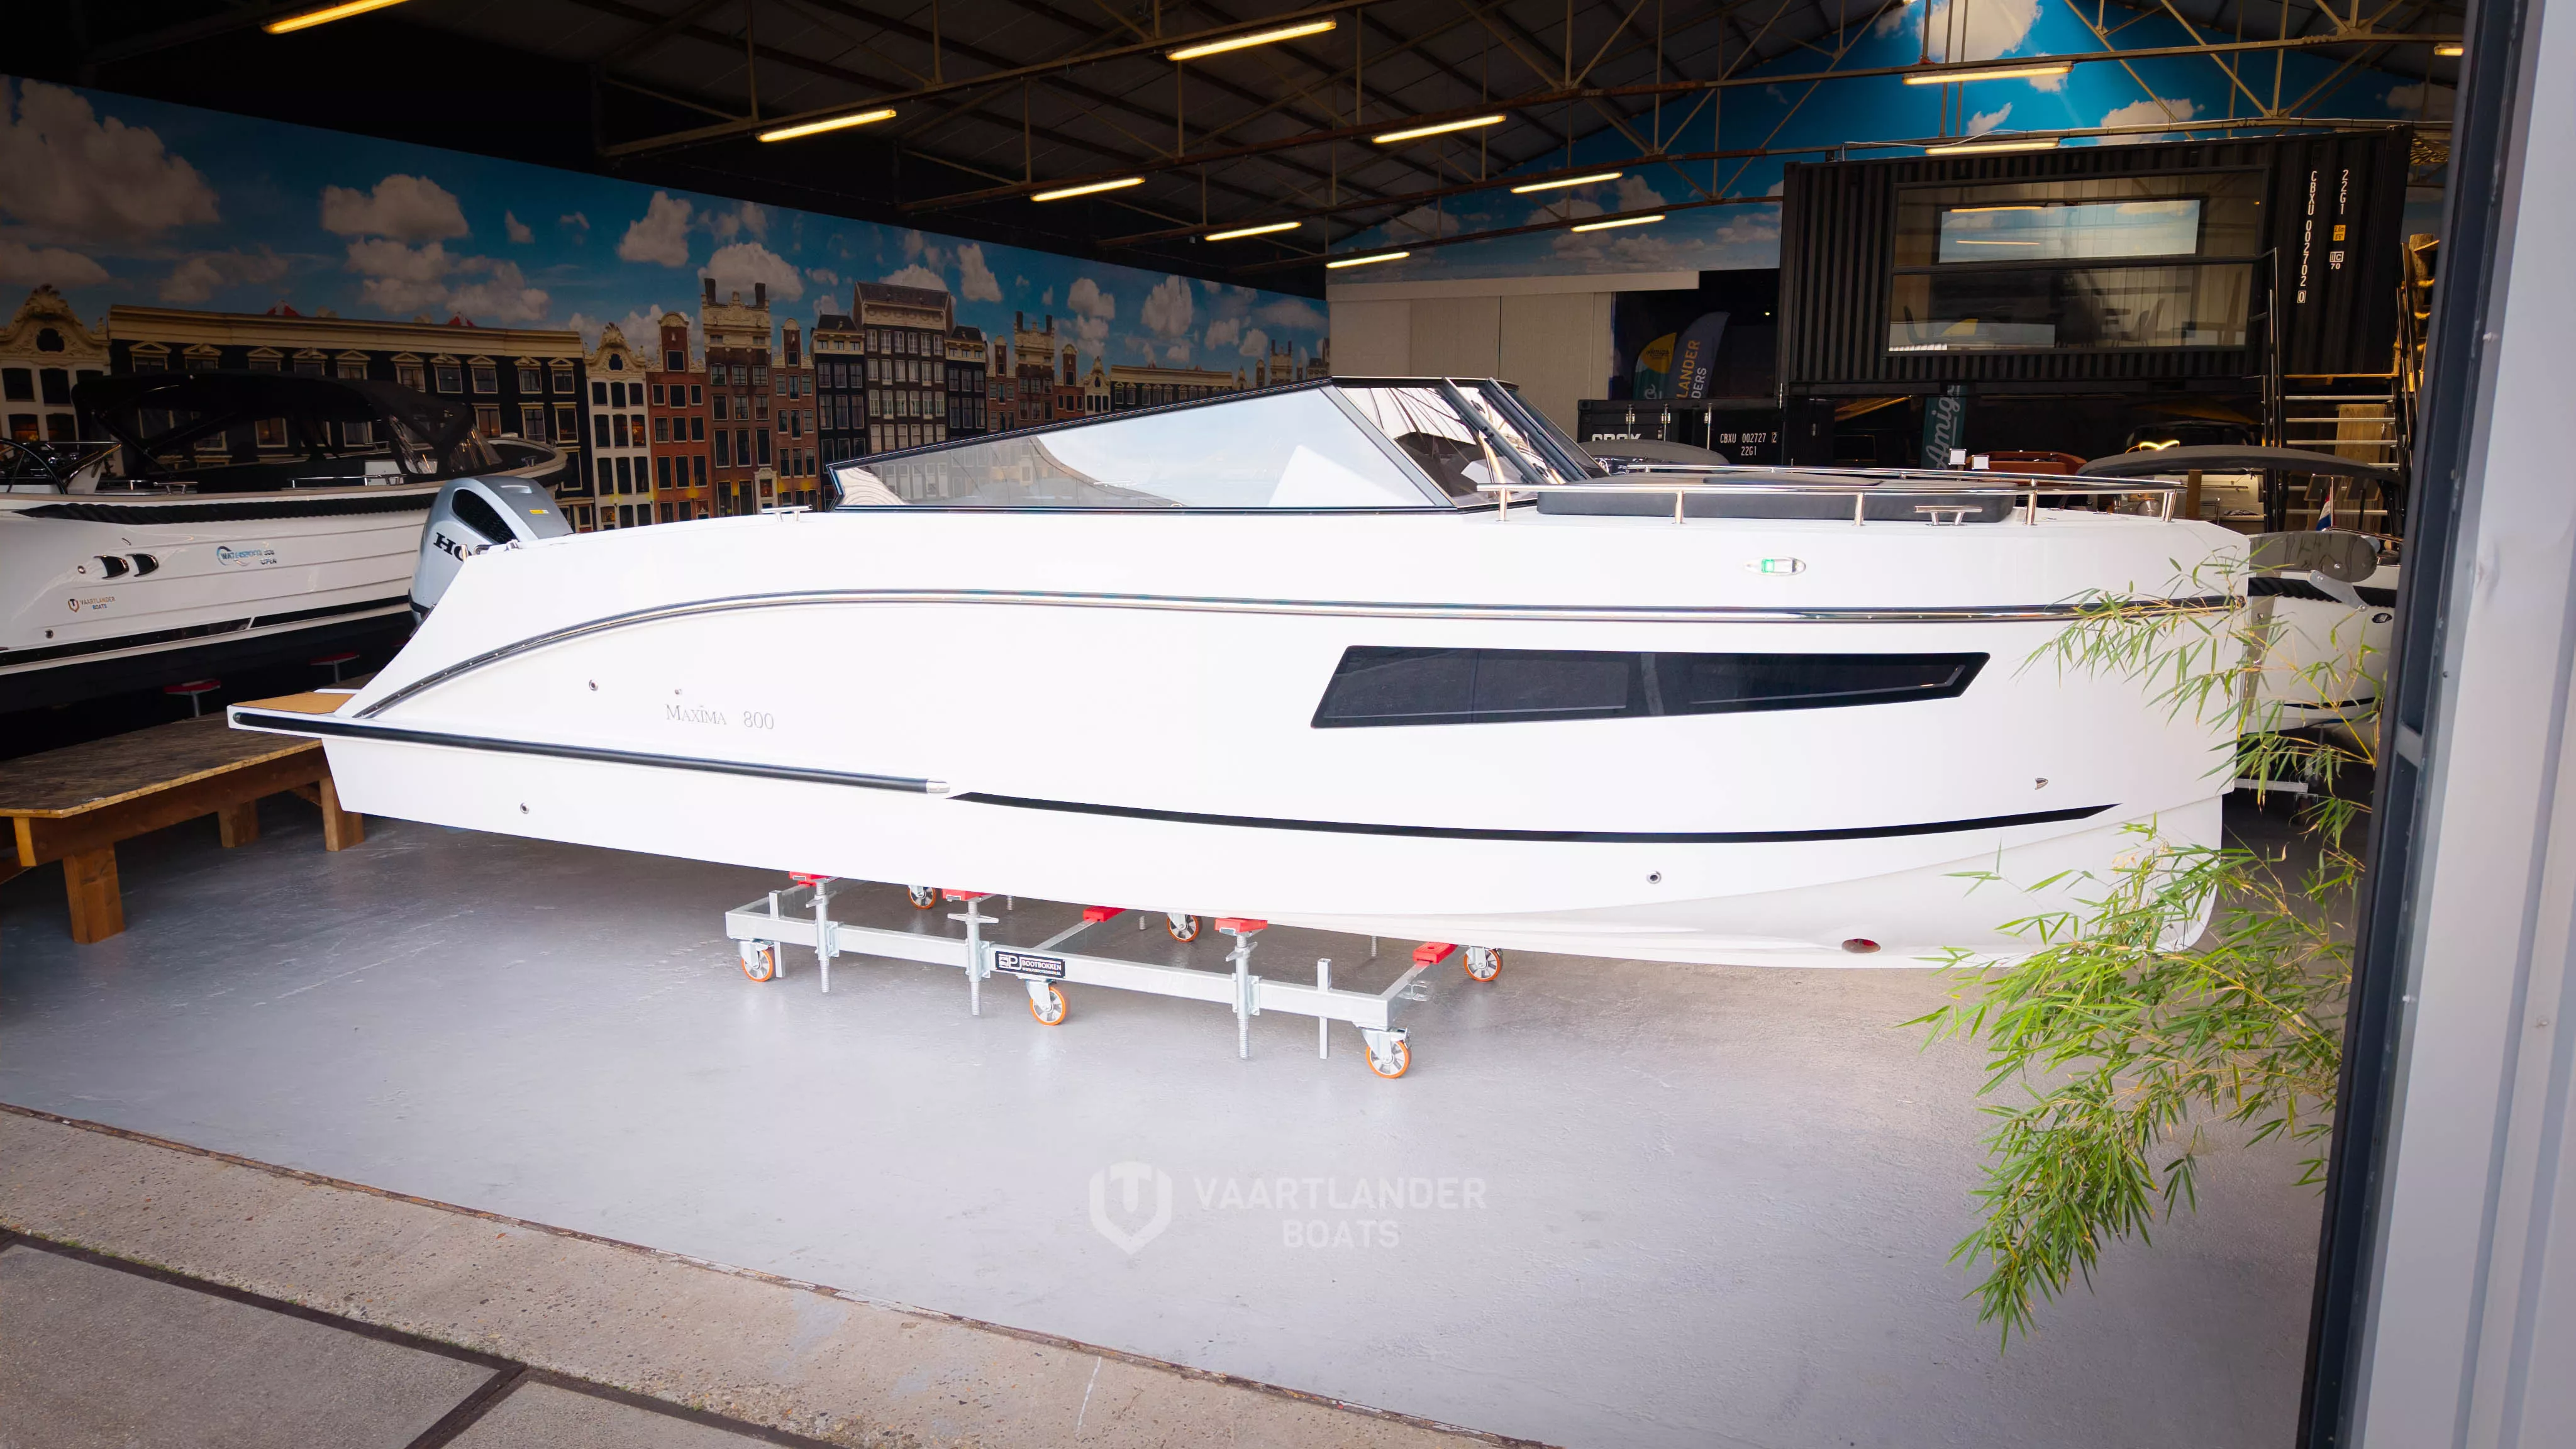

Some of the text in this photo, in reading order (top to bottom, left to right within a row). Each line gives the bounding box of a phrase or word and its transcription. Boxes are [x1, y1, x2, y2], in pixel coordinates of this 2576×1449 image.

[2307, 170, 2318, 215] CBXU
[2340, 169, 2349, 214] 22G1
[2300, 219, 2312, 287] 002702
[1676, 340, 1700, 399] LANDER
[1720, 432, 1778, 443] CBXU 002727 2
[1926, 385, 1960, 470] Amig
[1741, 446, 1757, 455] 22G1
[743, 710, 775, 730] 800
[1022, 960, 1062, 971] BOOTBOKKEN
